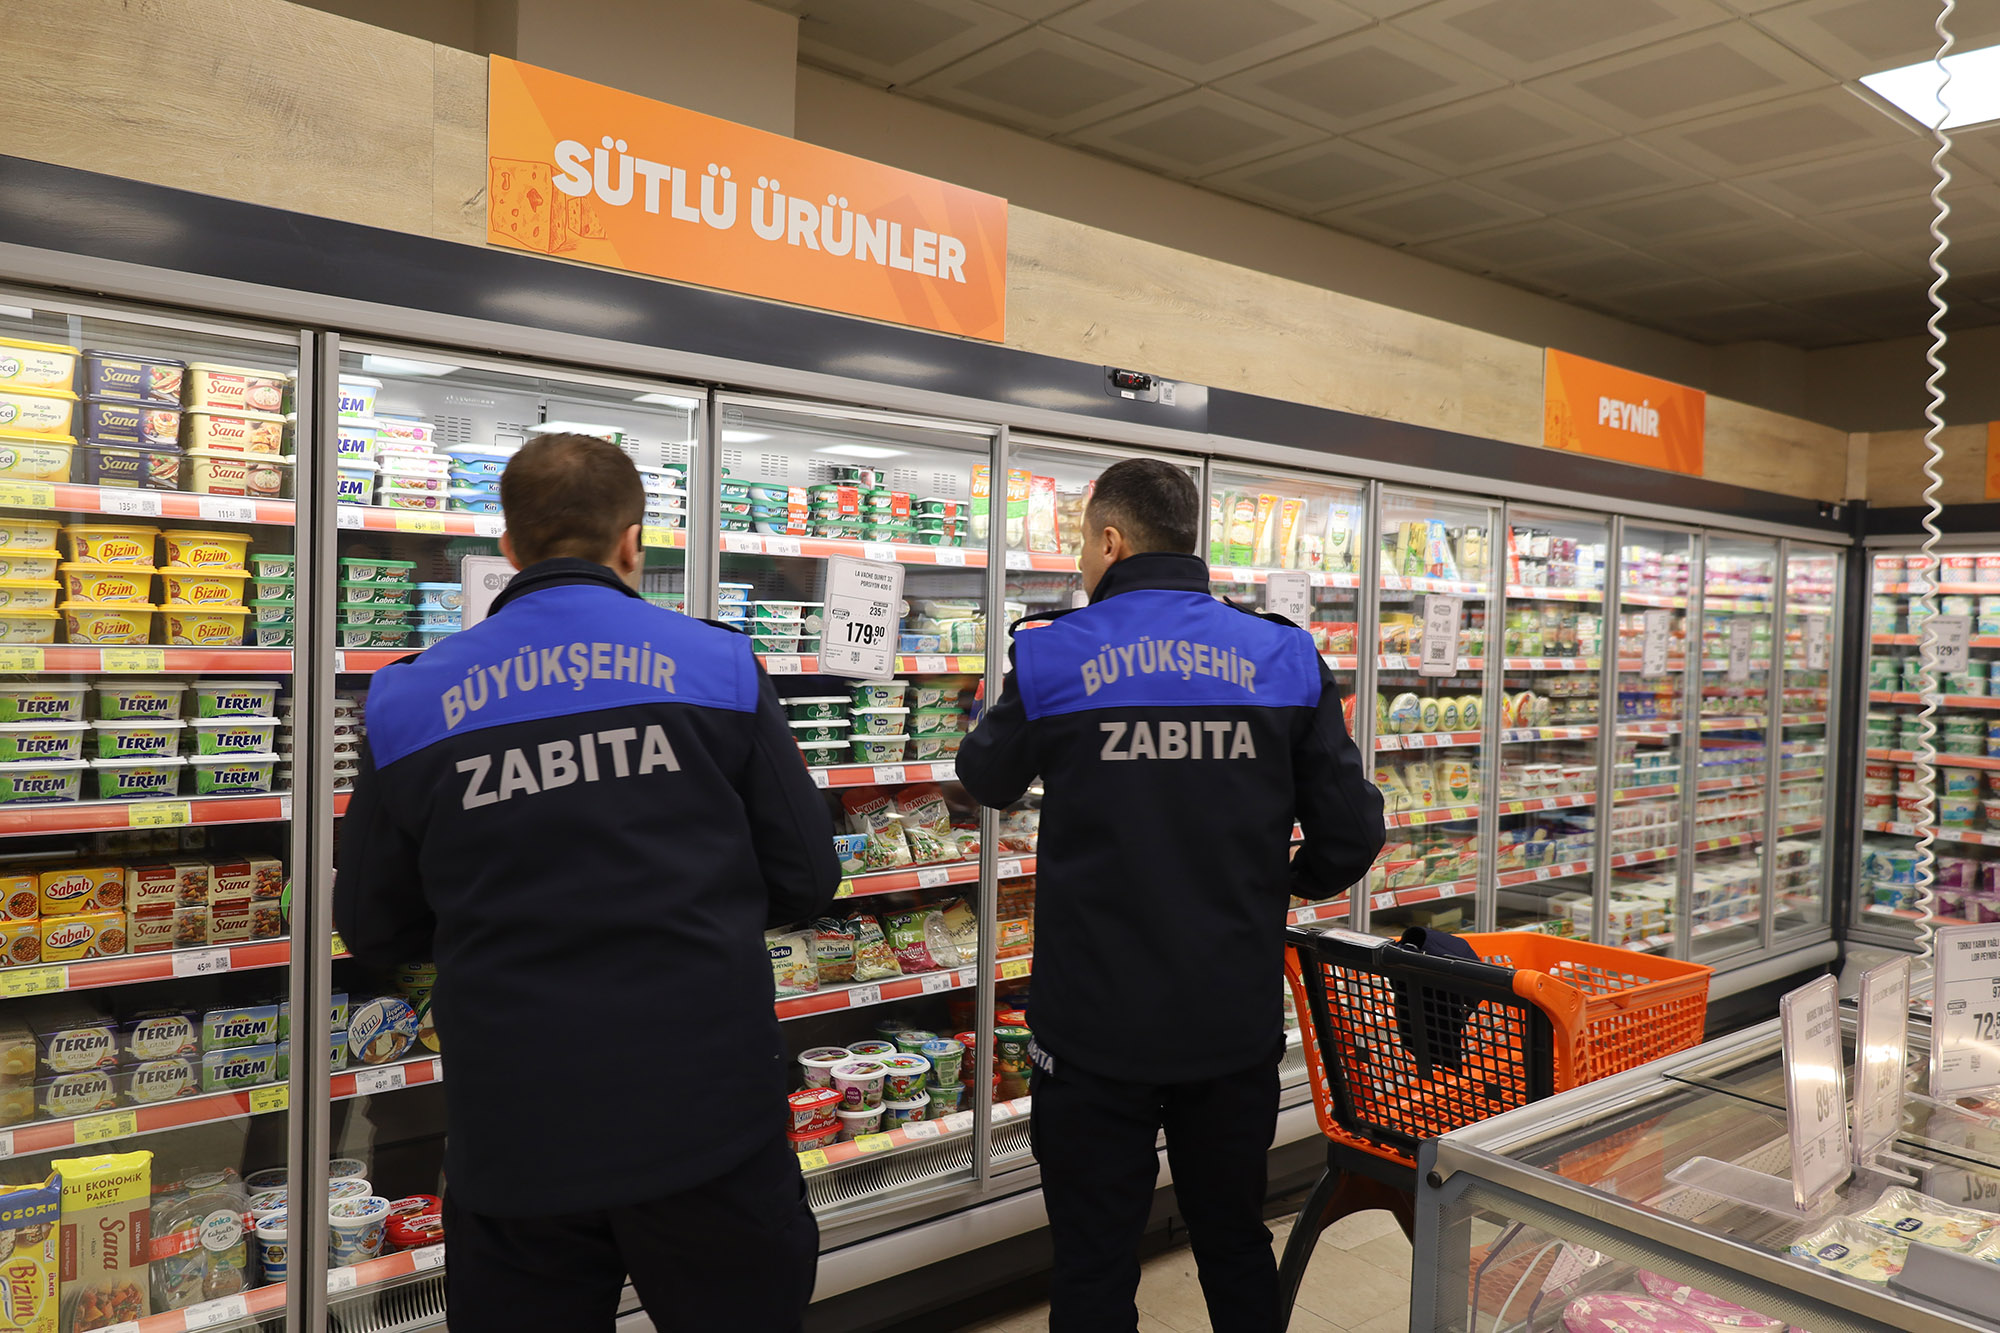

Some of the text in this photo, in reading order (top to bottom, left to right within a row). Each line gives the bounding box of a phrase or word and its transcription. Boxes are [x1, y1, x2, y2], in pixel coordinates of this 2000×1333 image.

[552, 136, 967, 284] SÜTLÜ ÜRÜNLER
[101, 367, 141, 384] Sana
[207, 380, 244, 396] Sana
[98, 411, 139, 427] Sana
[1598, 396, 1659, 437] PEYNİR
[208, 423, 245, 438] Sana
[99, 456, 139, 471] Sana
[483, 463, 497, 472] Kiri
[208, 465, 245, 479] Sana
[484, 502, 497, 511] Kiri
[103, 544, 139, 559] Bizim
[194, 549, 229, 563] Bizim
[97, 583, 134, 597] Bizim
[195, 586, 230, 600] Bizim
[93, 620, 132, 635] Bizim
[198, 624, 233, 639] Bizim
[1080, 636, 1257, 697] BÜYÜKŞEHİR
[441, 641, 677, 731] BÜYÜKŞEHİR
[17, 698, 70, 715] TEREM
[119, 697, 168, 714] TEREM
[216, 696, 262, 711] TEREM
[17, 738, 69, 753] TEREM
[117, 735, 166, 751] TEREM
[217, 732, 262, 748] TEREM
[1100, 721, 1257, 761] ZABITA
[456, 725, 681, 810] ZABITA
[13, 777, 66, 793] TEREM
[118, 773, 167, 789] TEREM
[214, 769, 260, 785] TEREM
[49, 880, 90, 898] Sabah
[137, 881, 175, 896] Sana
[214, 879, 250, 893] Sana
[134, 922, 172, 938] Sana
[213, 918, 248, 933] Sana
[50, 927, 90, 946] Sabah
[769, 948, 791, 957] Torku
[137, 1024, 188, 1041] TEREM
[214, 1021, 266, 1039] TEREM
[55, 1036, 109, 1053] TEREM
[137, 1067, 188, 1085] TEREM
[214, 1060, 265, 1080] TEREM
[53, 1080, 107, 1098] TEREM
[86, 1188, 120, 1202] PAKET
[209, 1216, 232, 1228] enka
[99, 1217, 125, 1270] Sana
[1820, 1246, 1848, 1260] Torku
[9, 1262, 38, 1320] Bizim
[48, 1272, 56, 1297] ÜLKER
